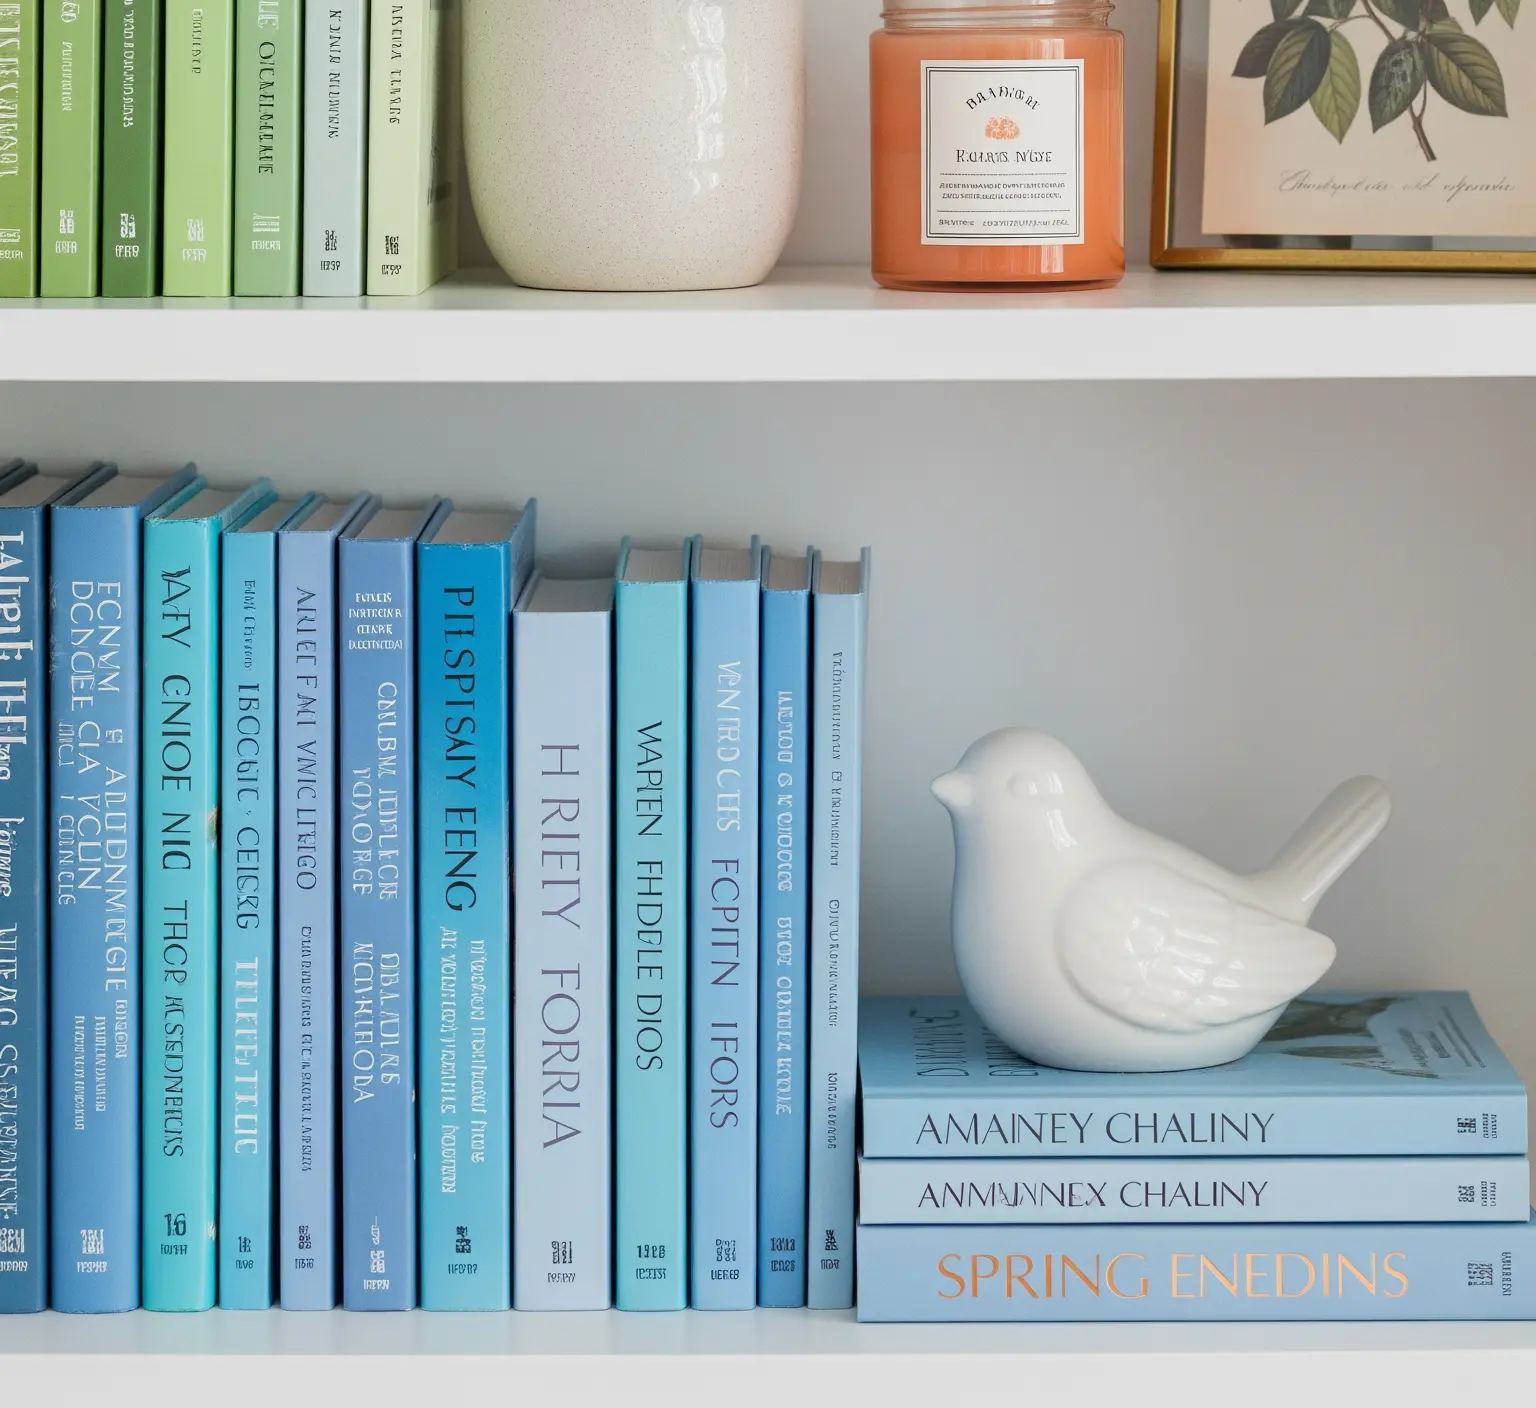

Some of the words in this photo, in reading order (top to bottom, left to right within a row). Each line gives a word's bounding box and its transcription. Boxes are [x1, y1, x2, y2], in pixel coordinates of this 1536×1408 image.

[636, 995, 662, 1070] DIOS
[1106, 1113, 1274, 1143] CHALINY
[1120, 1182, 1267, 1207] CHALINY
[938, 1254, 1148, 1299] SPRING
[1172, 1253, 1408, 1298] ENEDINS
